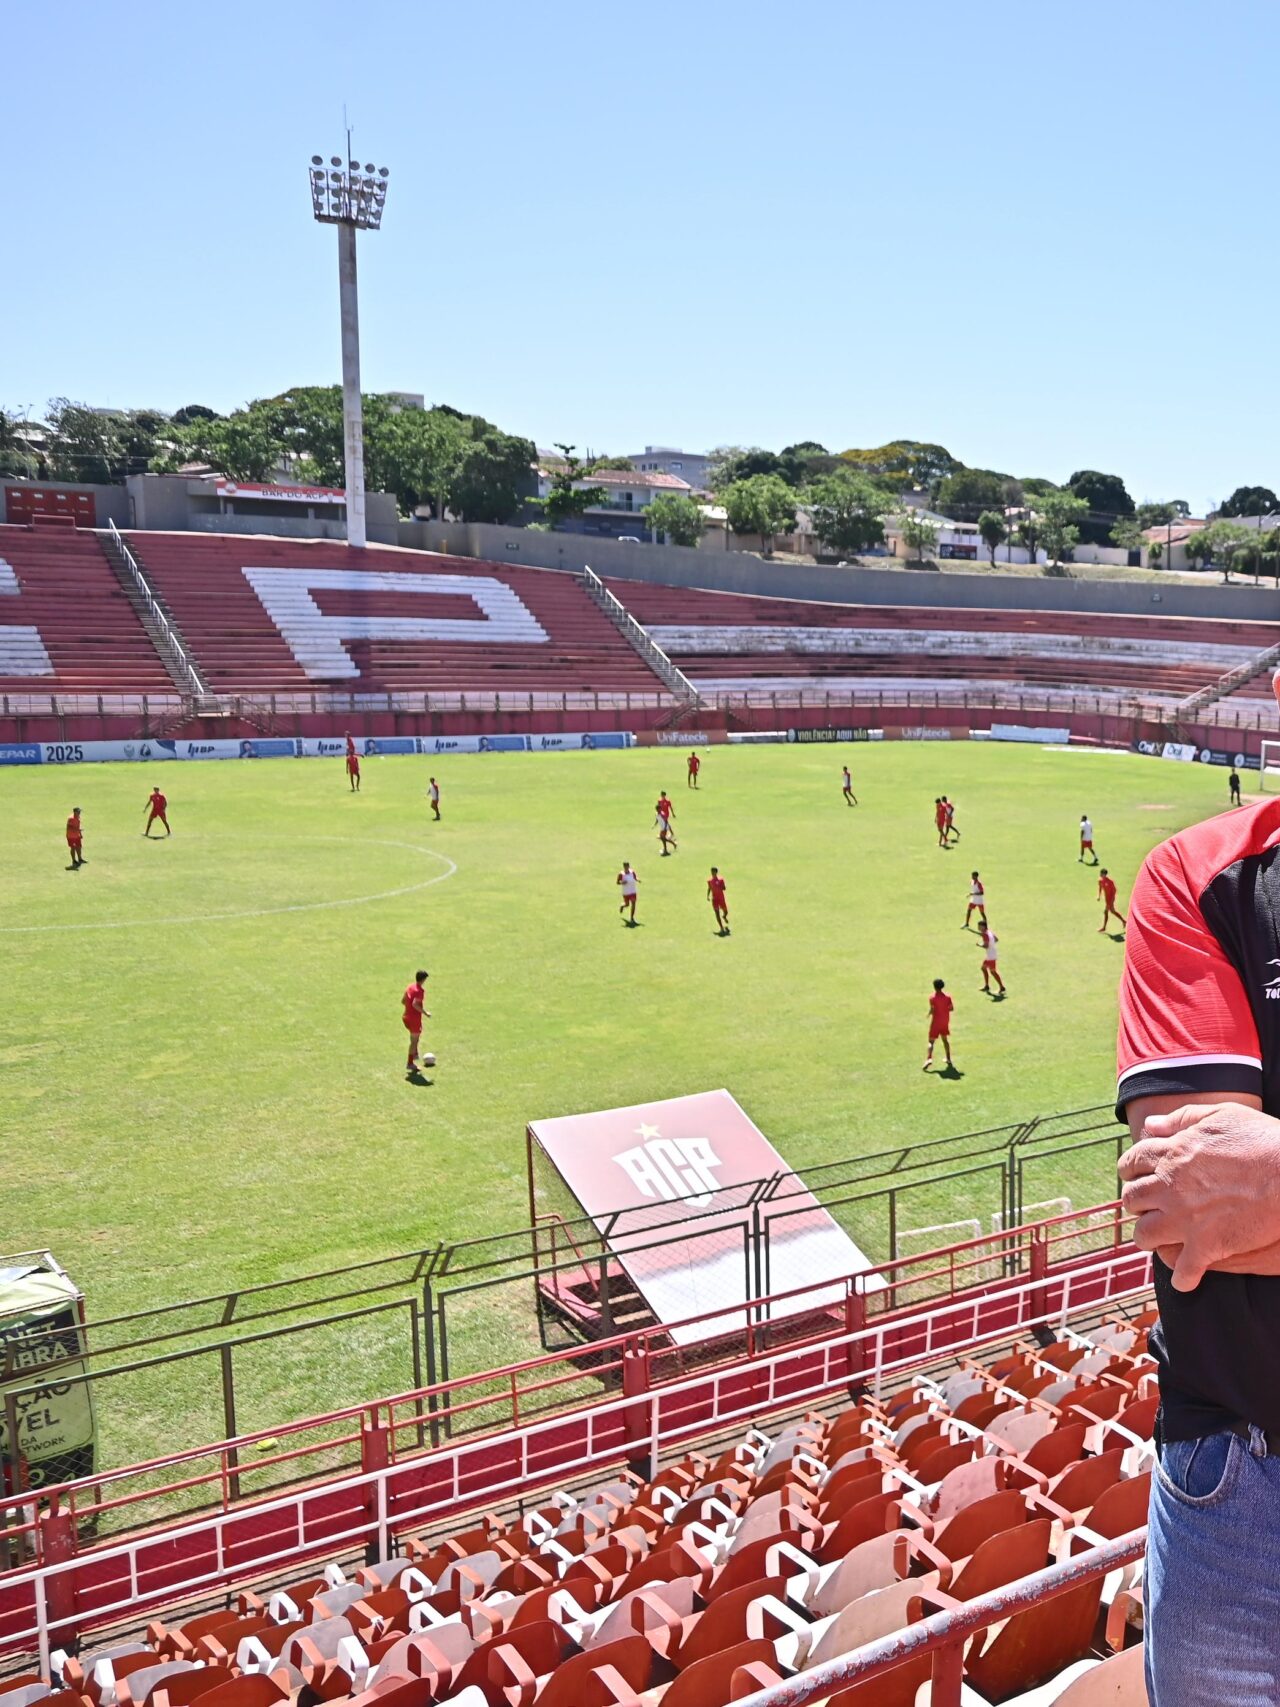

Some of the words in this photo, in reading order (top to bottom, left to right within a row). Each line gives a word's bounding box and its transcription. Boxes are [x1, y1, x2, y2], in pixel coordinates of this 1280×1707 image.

[261, 489, 283, 498] BAR
[286, 491, 302, 499] DO
[305, 492, 325, 500] ACP
[46, 744, 83, 762] 2025
[611, 1136, 723, 1208] ACP
